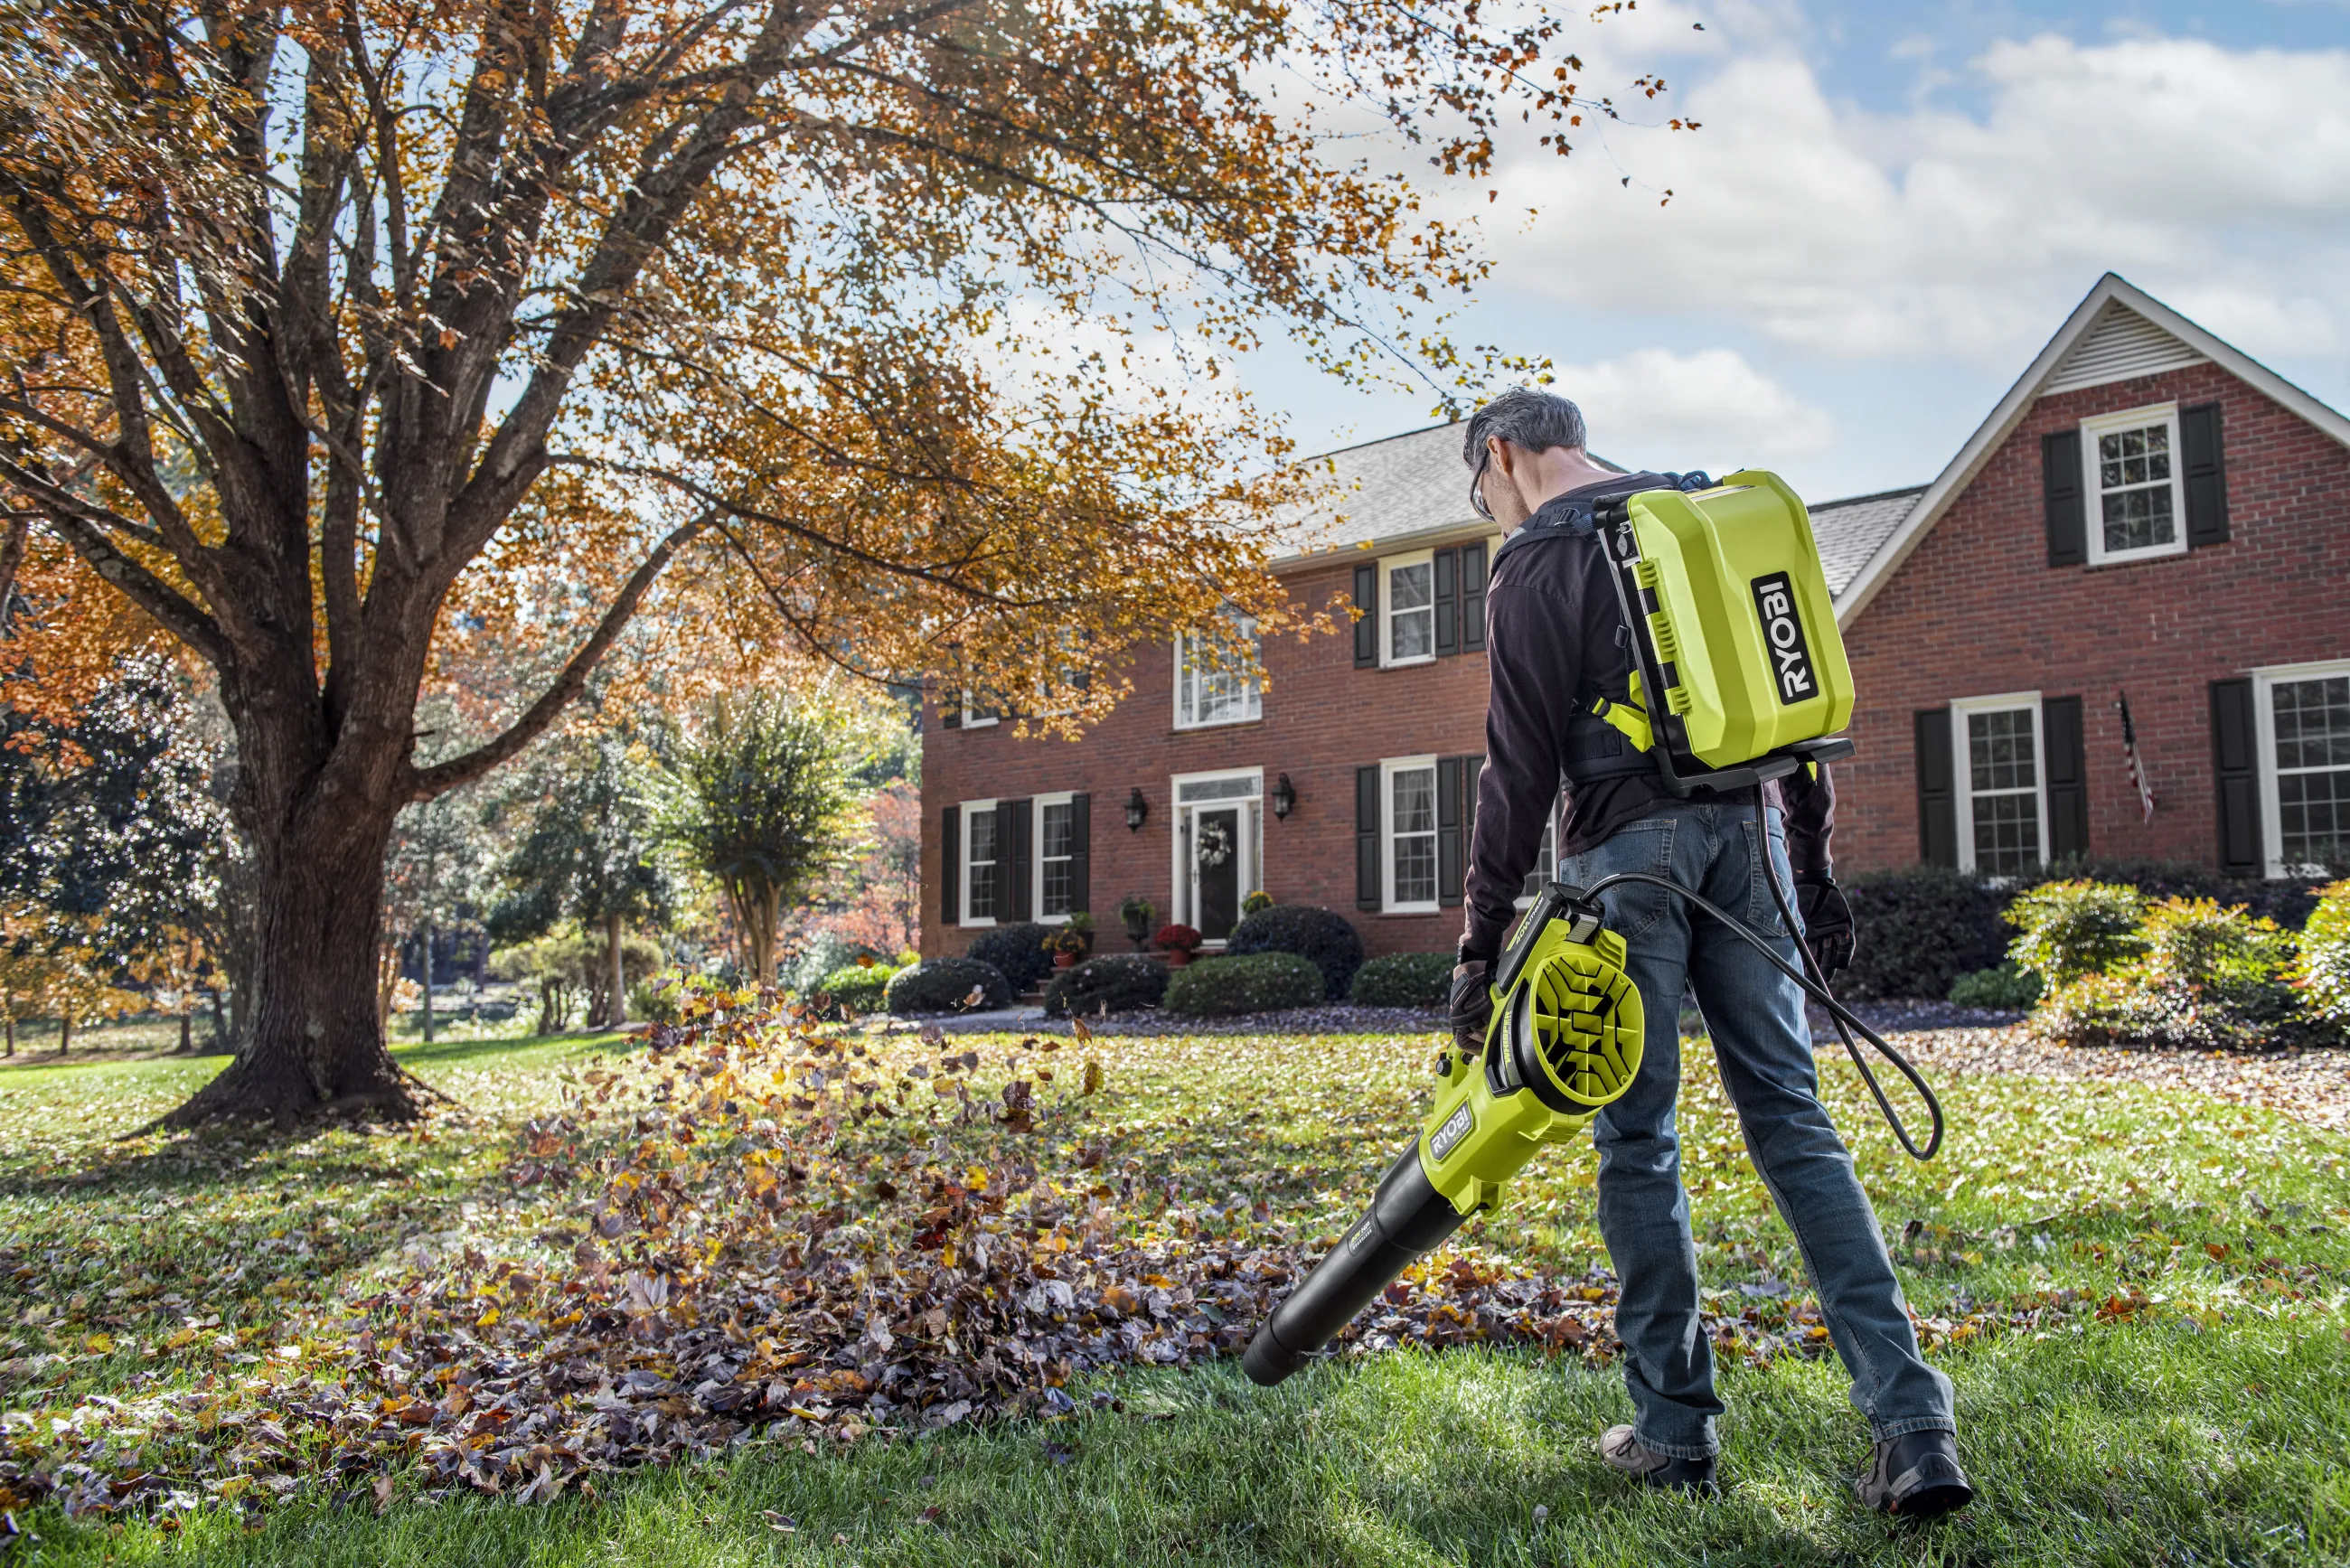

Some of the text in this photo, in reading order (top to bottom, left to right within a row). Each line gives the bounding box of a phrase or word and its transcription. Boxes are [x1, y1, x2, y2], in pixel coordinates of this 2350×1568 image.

[1759, 581, 1810, 698] RYOBI
[1503, 1010, 1511, 1067] WHISPER
[1431, 1105, 1469, 1154] RYOBI
[1452, 1121, 1471, 1141] 40V HP
